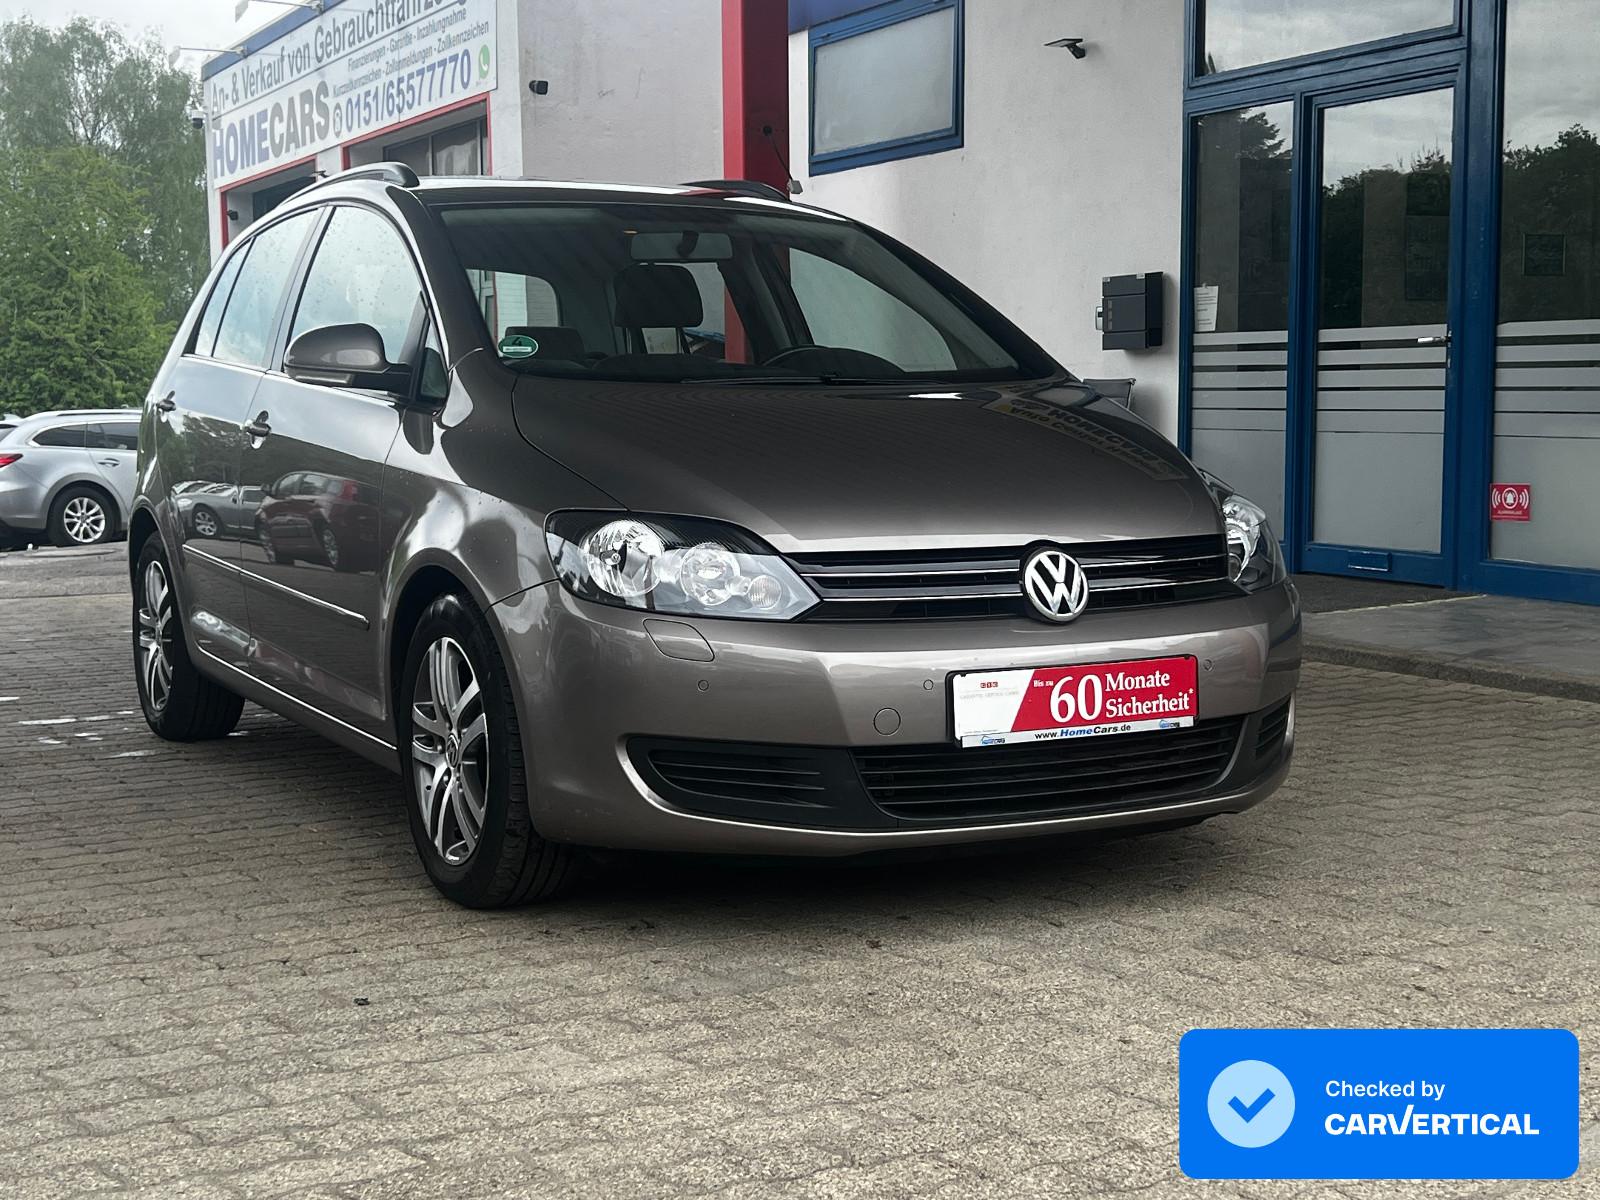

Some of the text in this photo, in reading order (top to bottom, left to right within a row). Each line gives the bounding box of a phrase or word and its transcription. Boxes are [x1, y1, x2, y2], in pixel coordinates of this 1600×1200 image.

[241, 45, 286, 100] Verkauf
[287, 42, 310, 77] von
[345, 48, 472, 133] 0151/65577770
[212, 79, 330, 180] HOMECARS
[1050, 674, 1103, 723] 60
[1105, 670, 1171, 692] Monate
[1034, 723, 1132, 740] www.HomeCars.de
